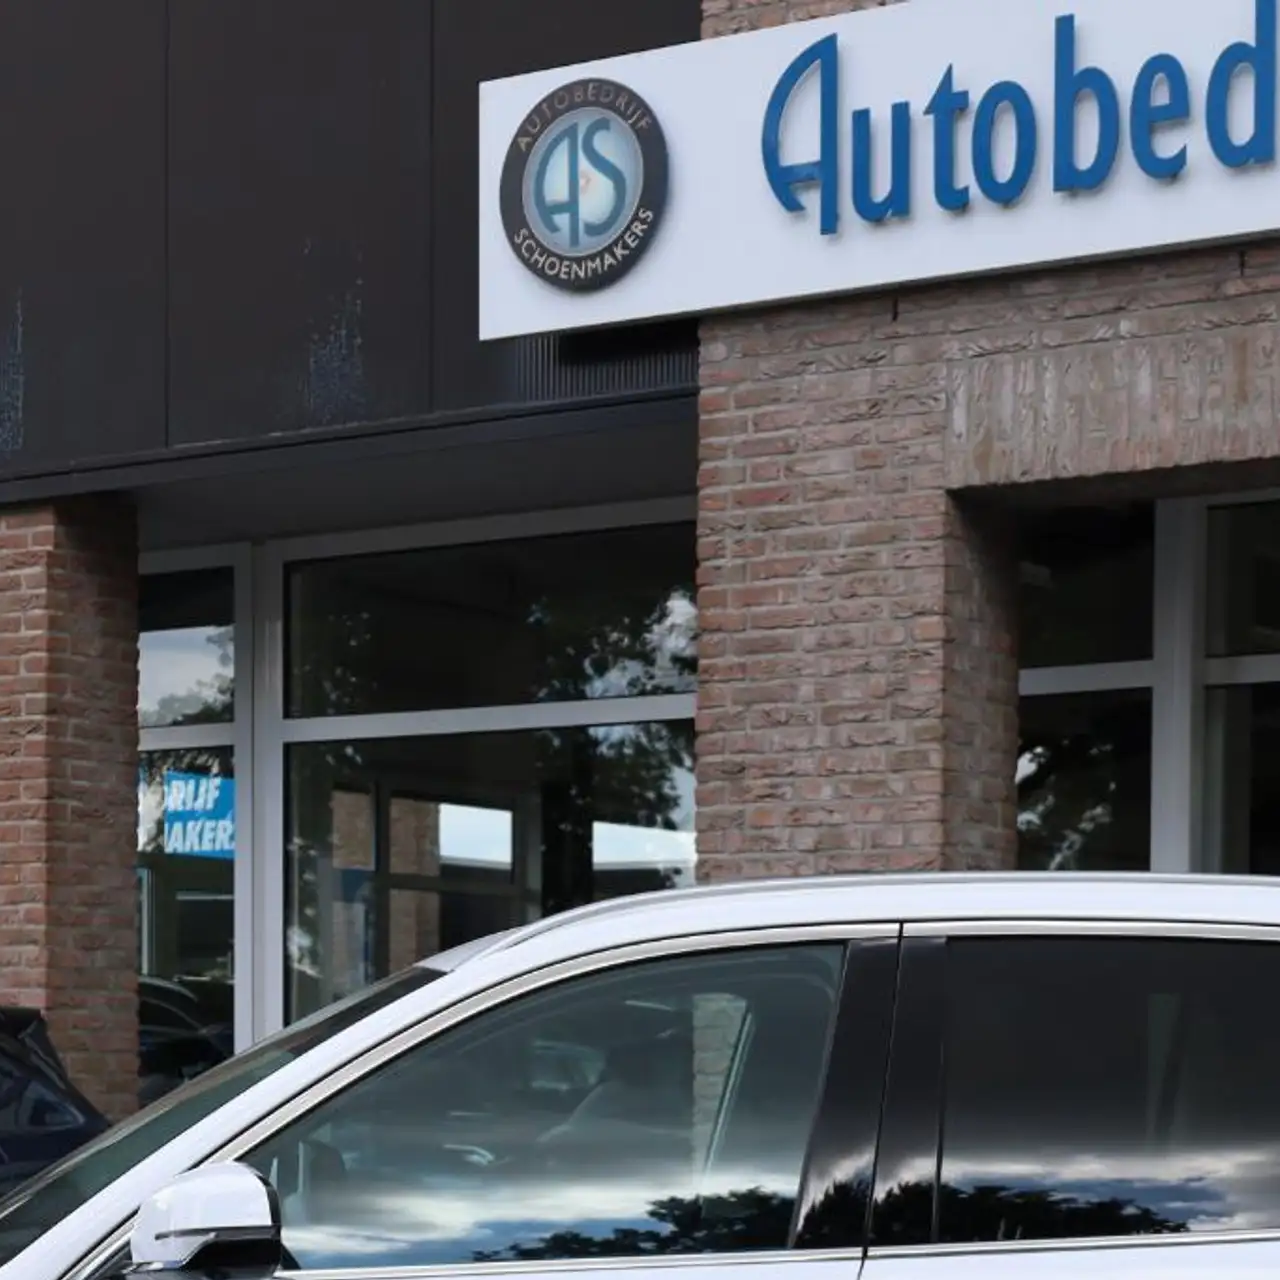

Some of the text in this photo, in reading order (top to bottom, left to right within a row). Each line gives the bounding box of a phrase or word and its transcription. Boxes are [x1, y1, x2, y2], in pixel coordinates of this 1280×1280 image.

[517, 82, 652, 152] AUTOBEDRIJF
[534, 116, 627, 248] AS
[514, 207, 654, 280] SCHOENMAKERS
[164, 775, 222, 811] RIJF
[164, 819, 235, 854] AKER
